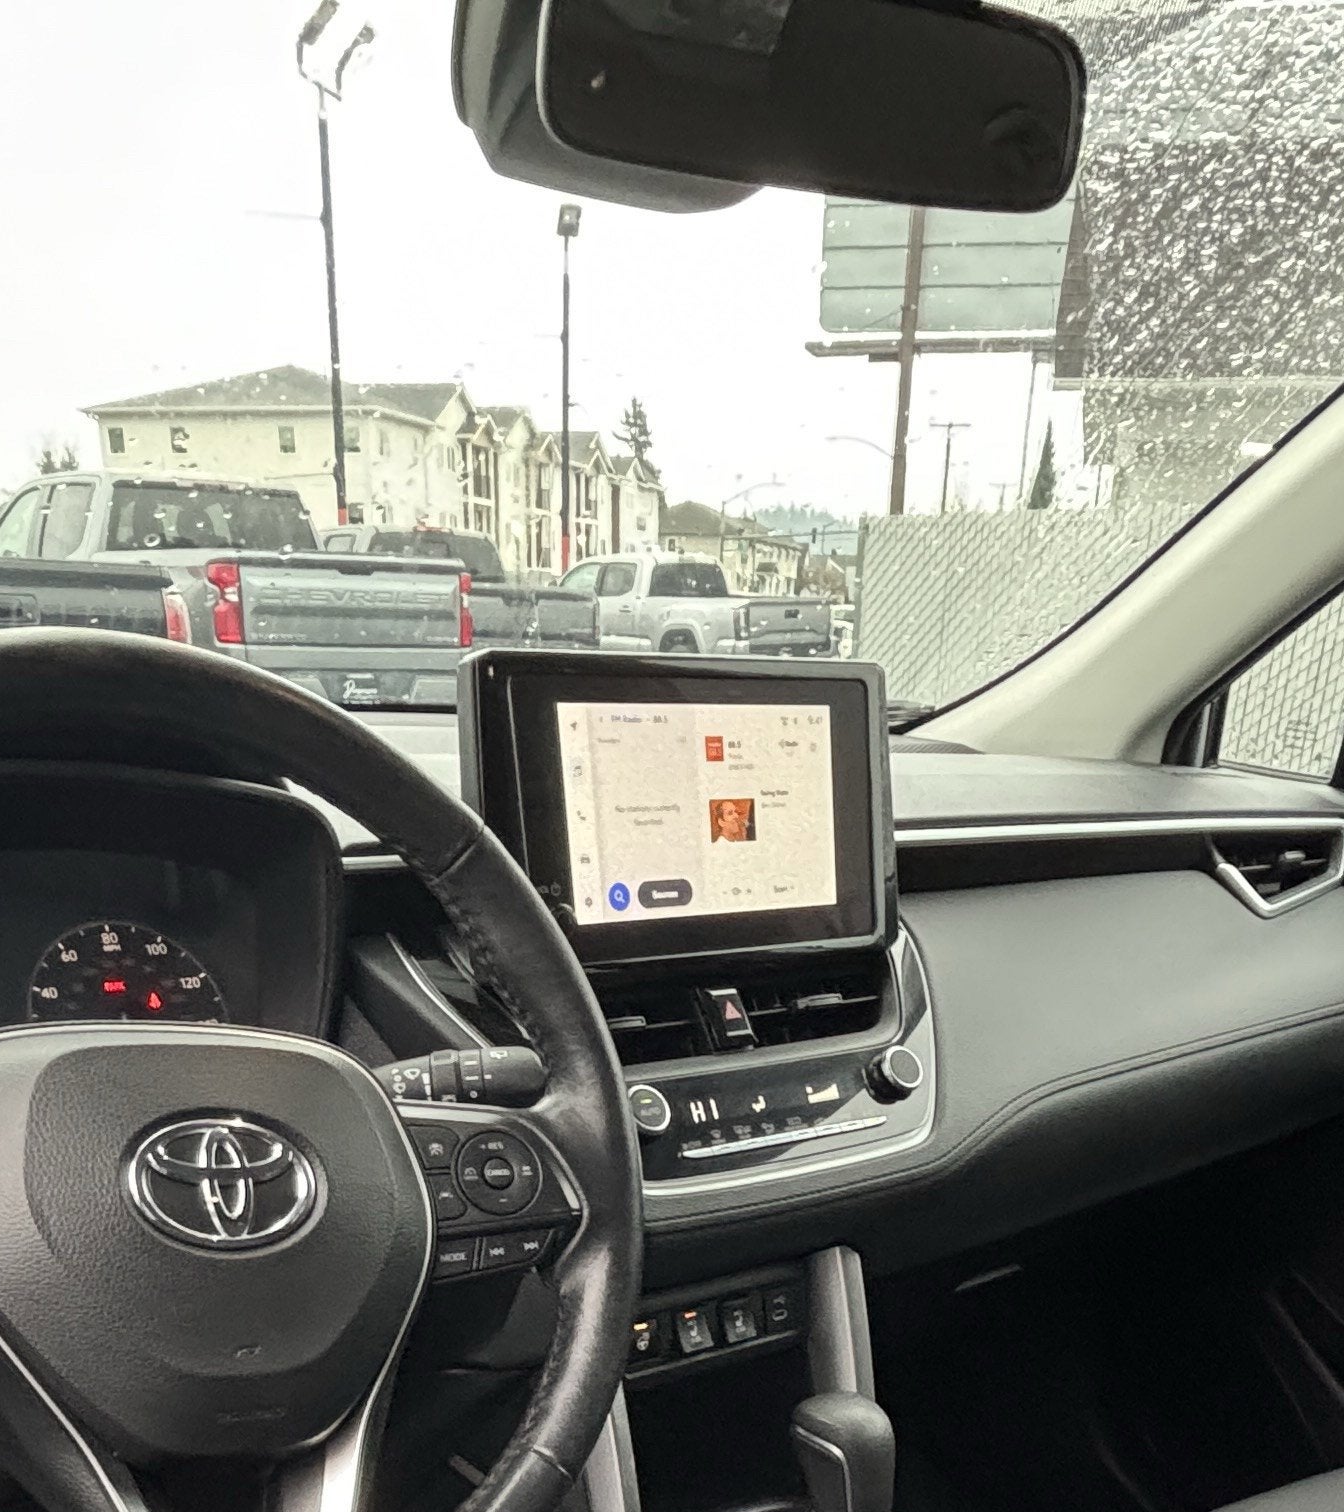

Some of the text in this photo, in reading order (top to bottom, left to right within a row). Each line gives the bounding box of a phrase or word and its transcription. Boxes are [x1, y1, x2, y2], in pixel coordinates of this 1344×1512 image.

[101, 933, 118, 944] 80
[60, 950, 78, 962] 60
[145, 943, 168, 956] 100
[179, 976, 201, 989] 120
[40, 986, 58, 999] 40
[689, 1098, 719, 1124] HI
[440, 1252, 467, 1263] MODE
